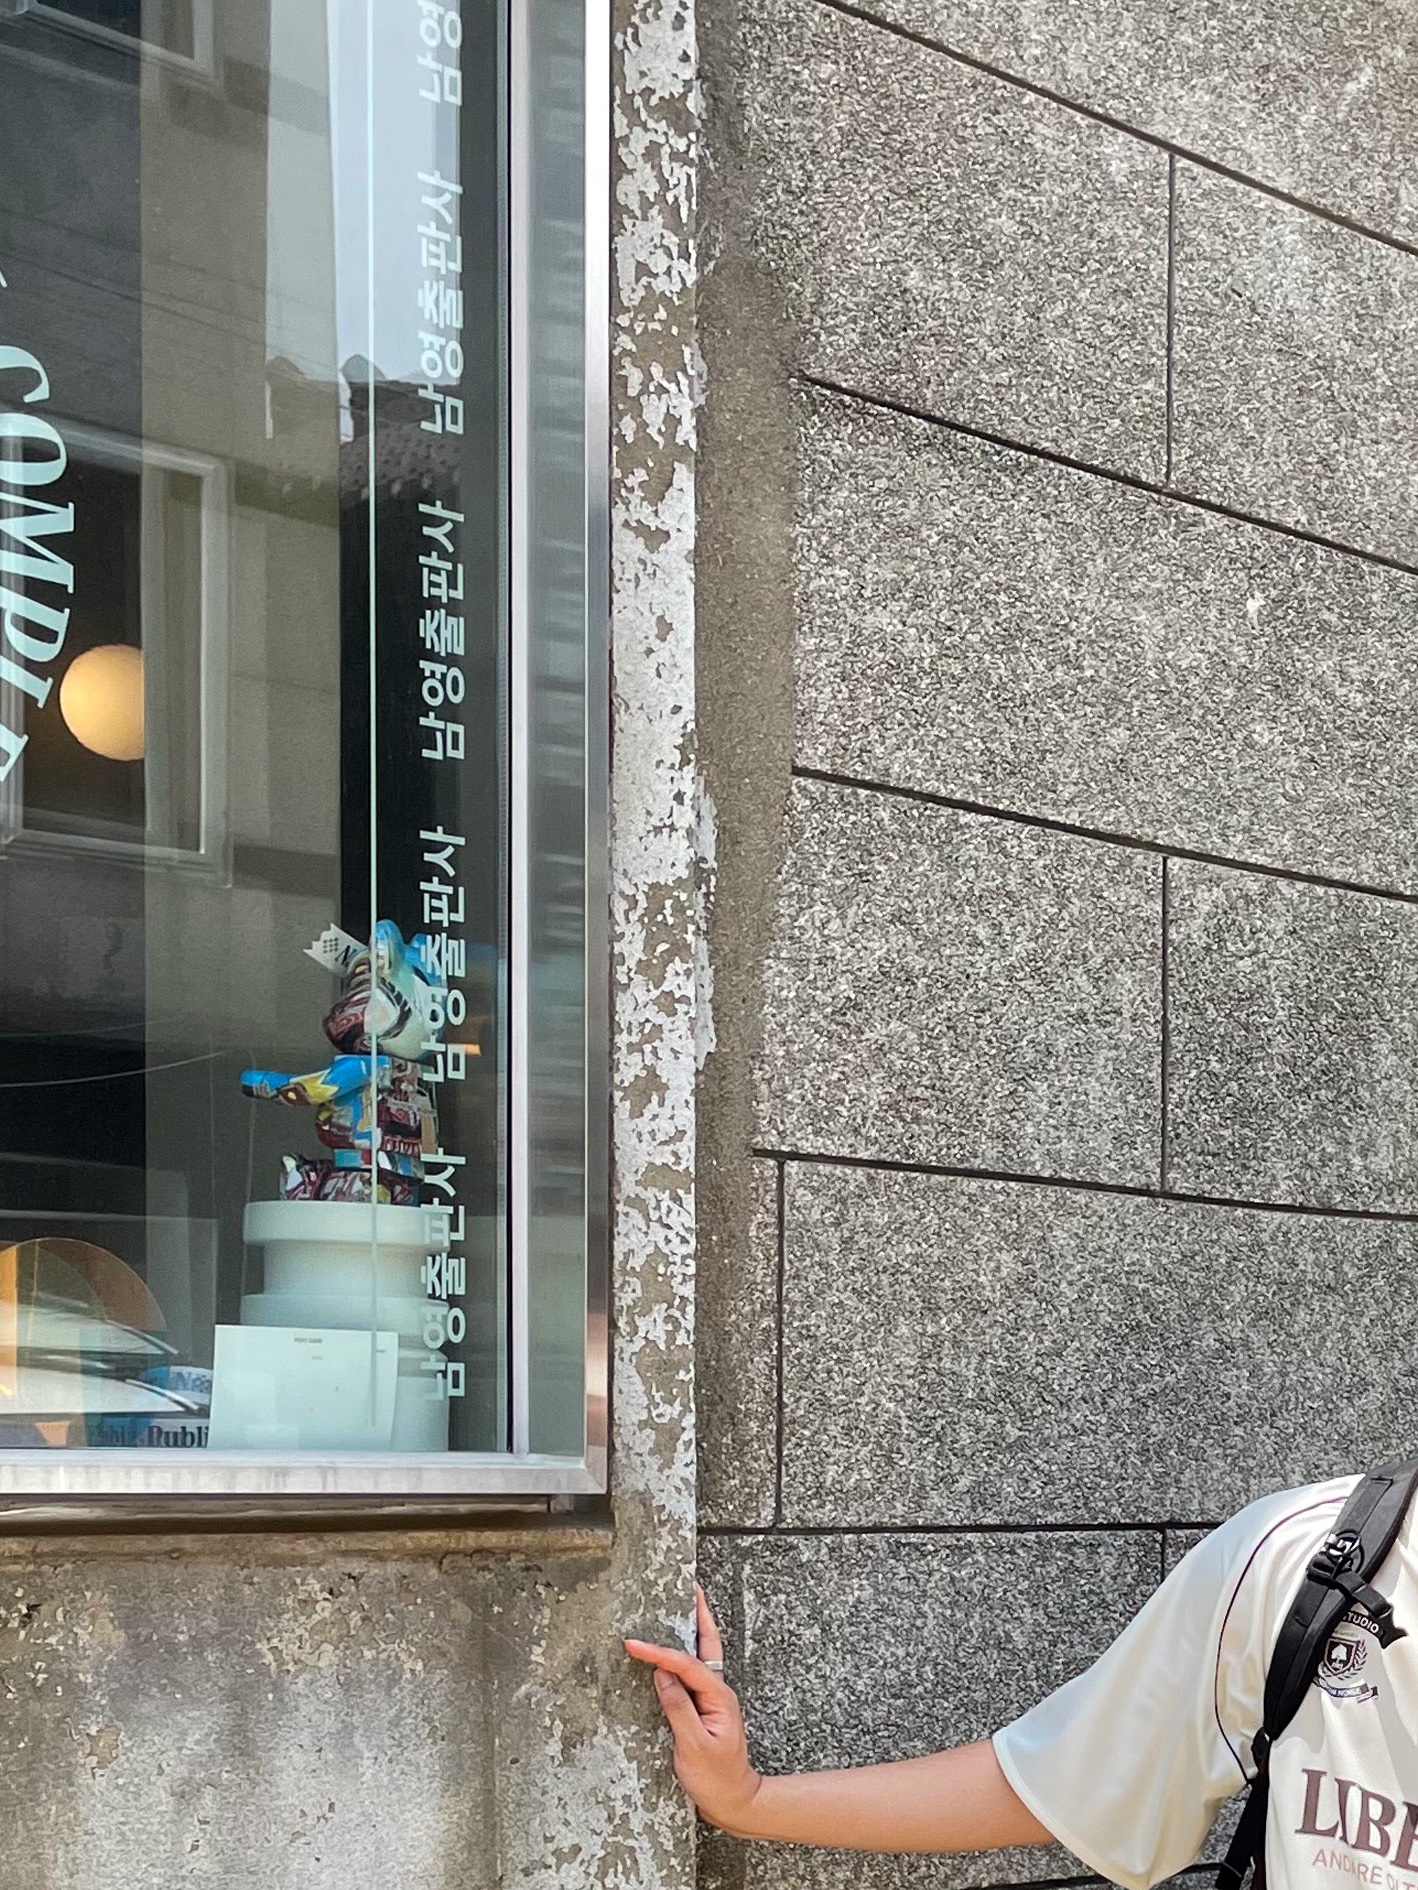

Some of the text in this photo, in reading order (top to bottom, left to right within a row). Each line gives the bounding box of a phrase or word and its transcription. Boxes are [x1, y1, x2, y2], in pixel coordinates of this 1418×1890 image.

[416, 168, 465, 436] 남영출판사
[418, 500, 465, 760] 남영출판사
[418, 825, 466, 1081] 남영출판사
[419, 1146, 467, 1400] 남영출판사
[1342, 1610, 1380, 1634] TUDIO
